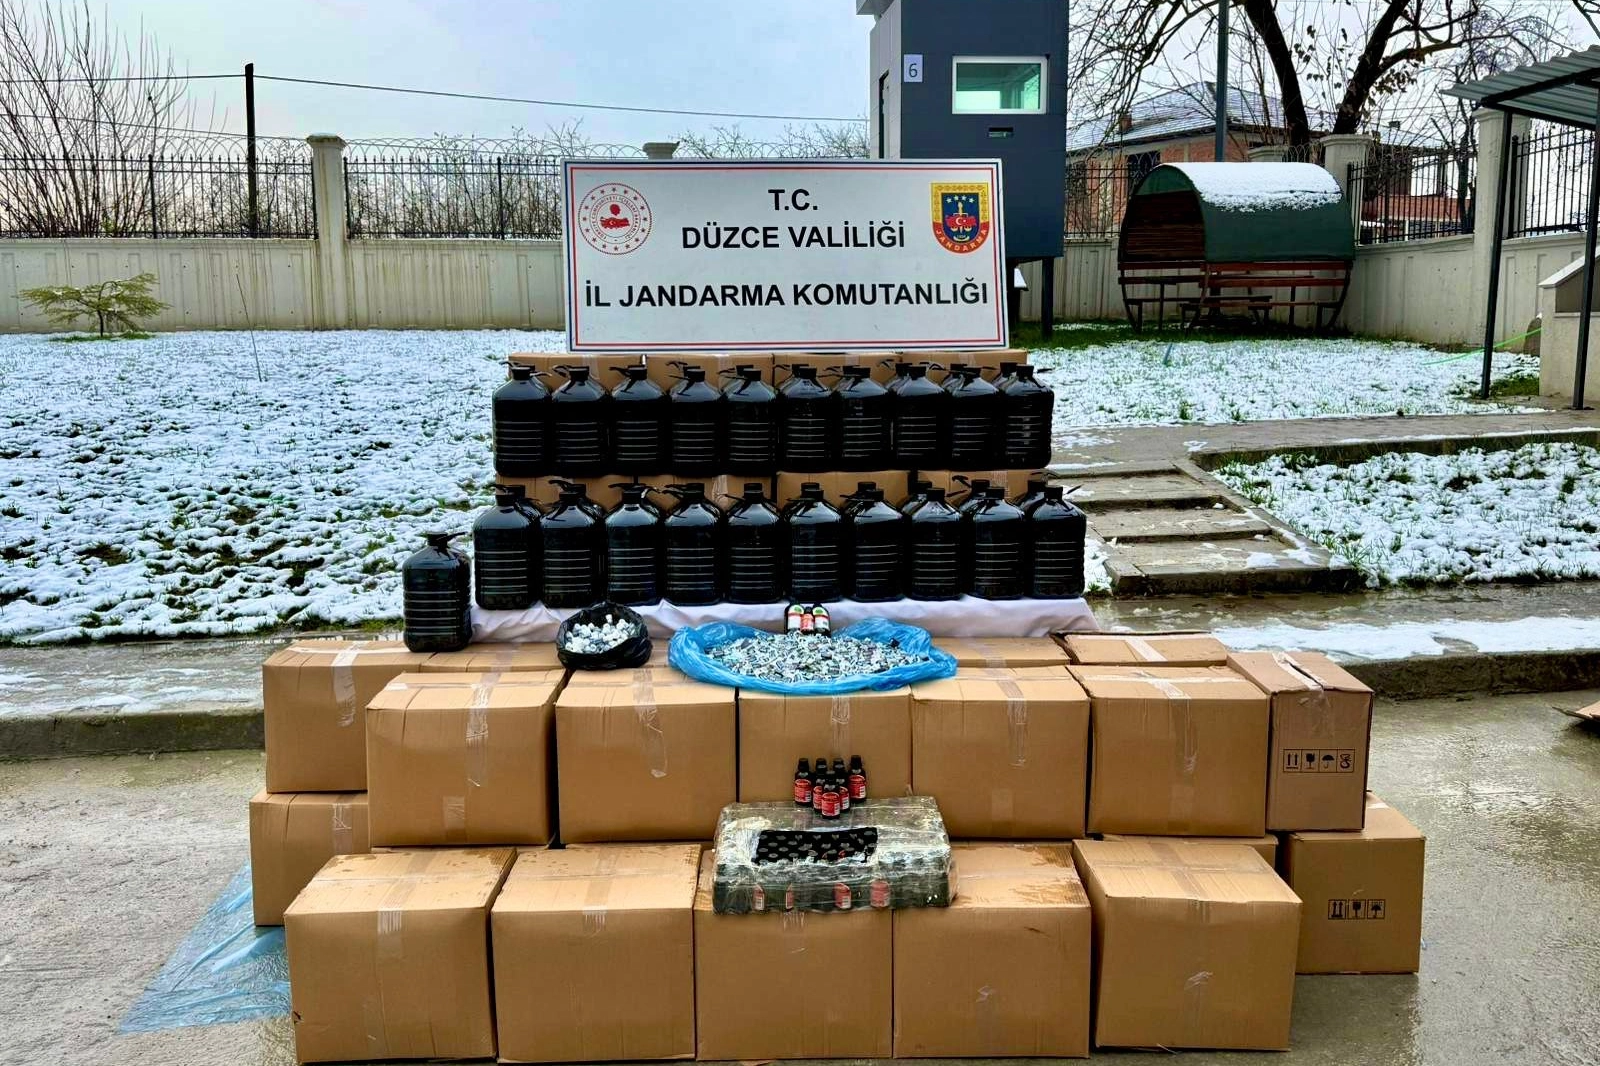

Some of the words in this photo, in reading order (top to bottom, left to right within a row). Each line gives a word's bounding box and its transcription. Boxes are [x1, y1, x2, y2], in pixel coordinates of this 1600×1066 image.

[908, 63, 918, 78] 6
[768, 189, 819, 211] T.C.
[682, 221, 780, 249] DÜZCE
[787, 220, 905, 248] VALİLİĞİ
[936, 229, 988, 251] JANDARMA
[585, 280, 611, 307] İL
[619, 284, 785, 307] JANDARMA
[793, 277, 988, 306] KOMUTANLIĞI
